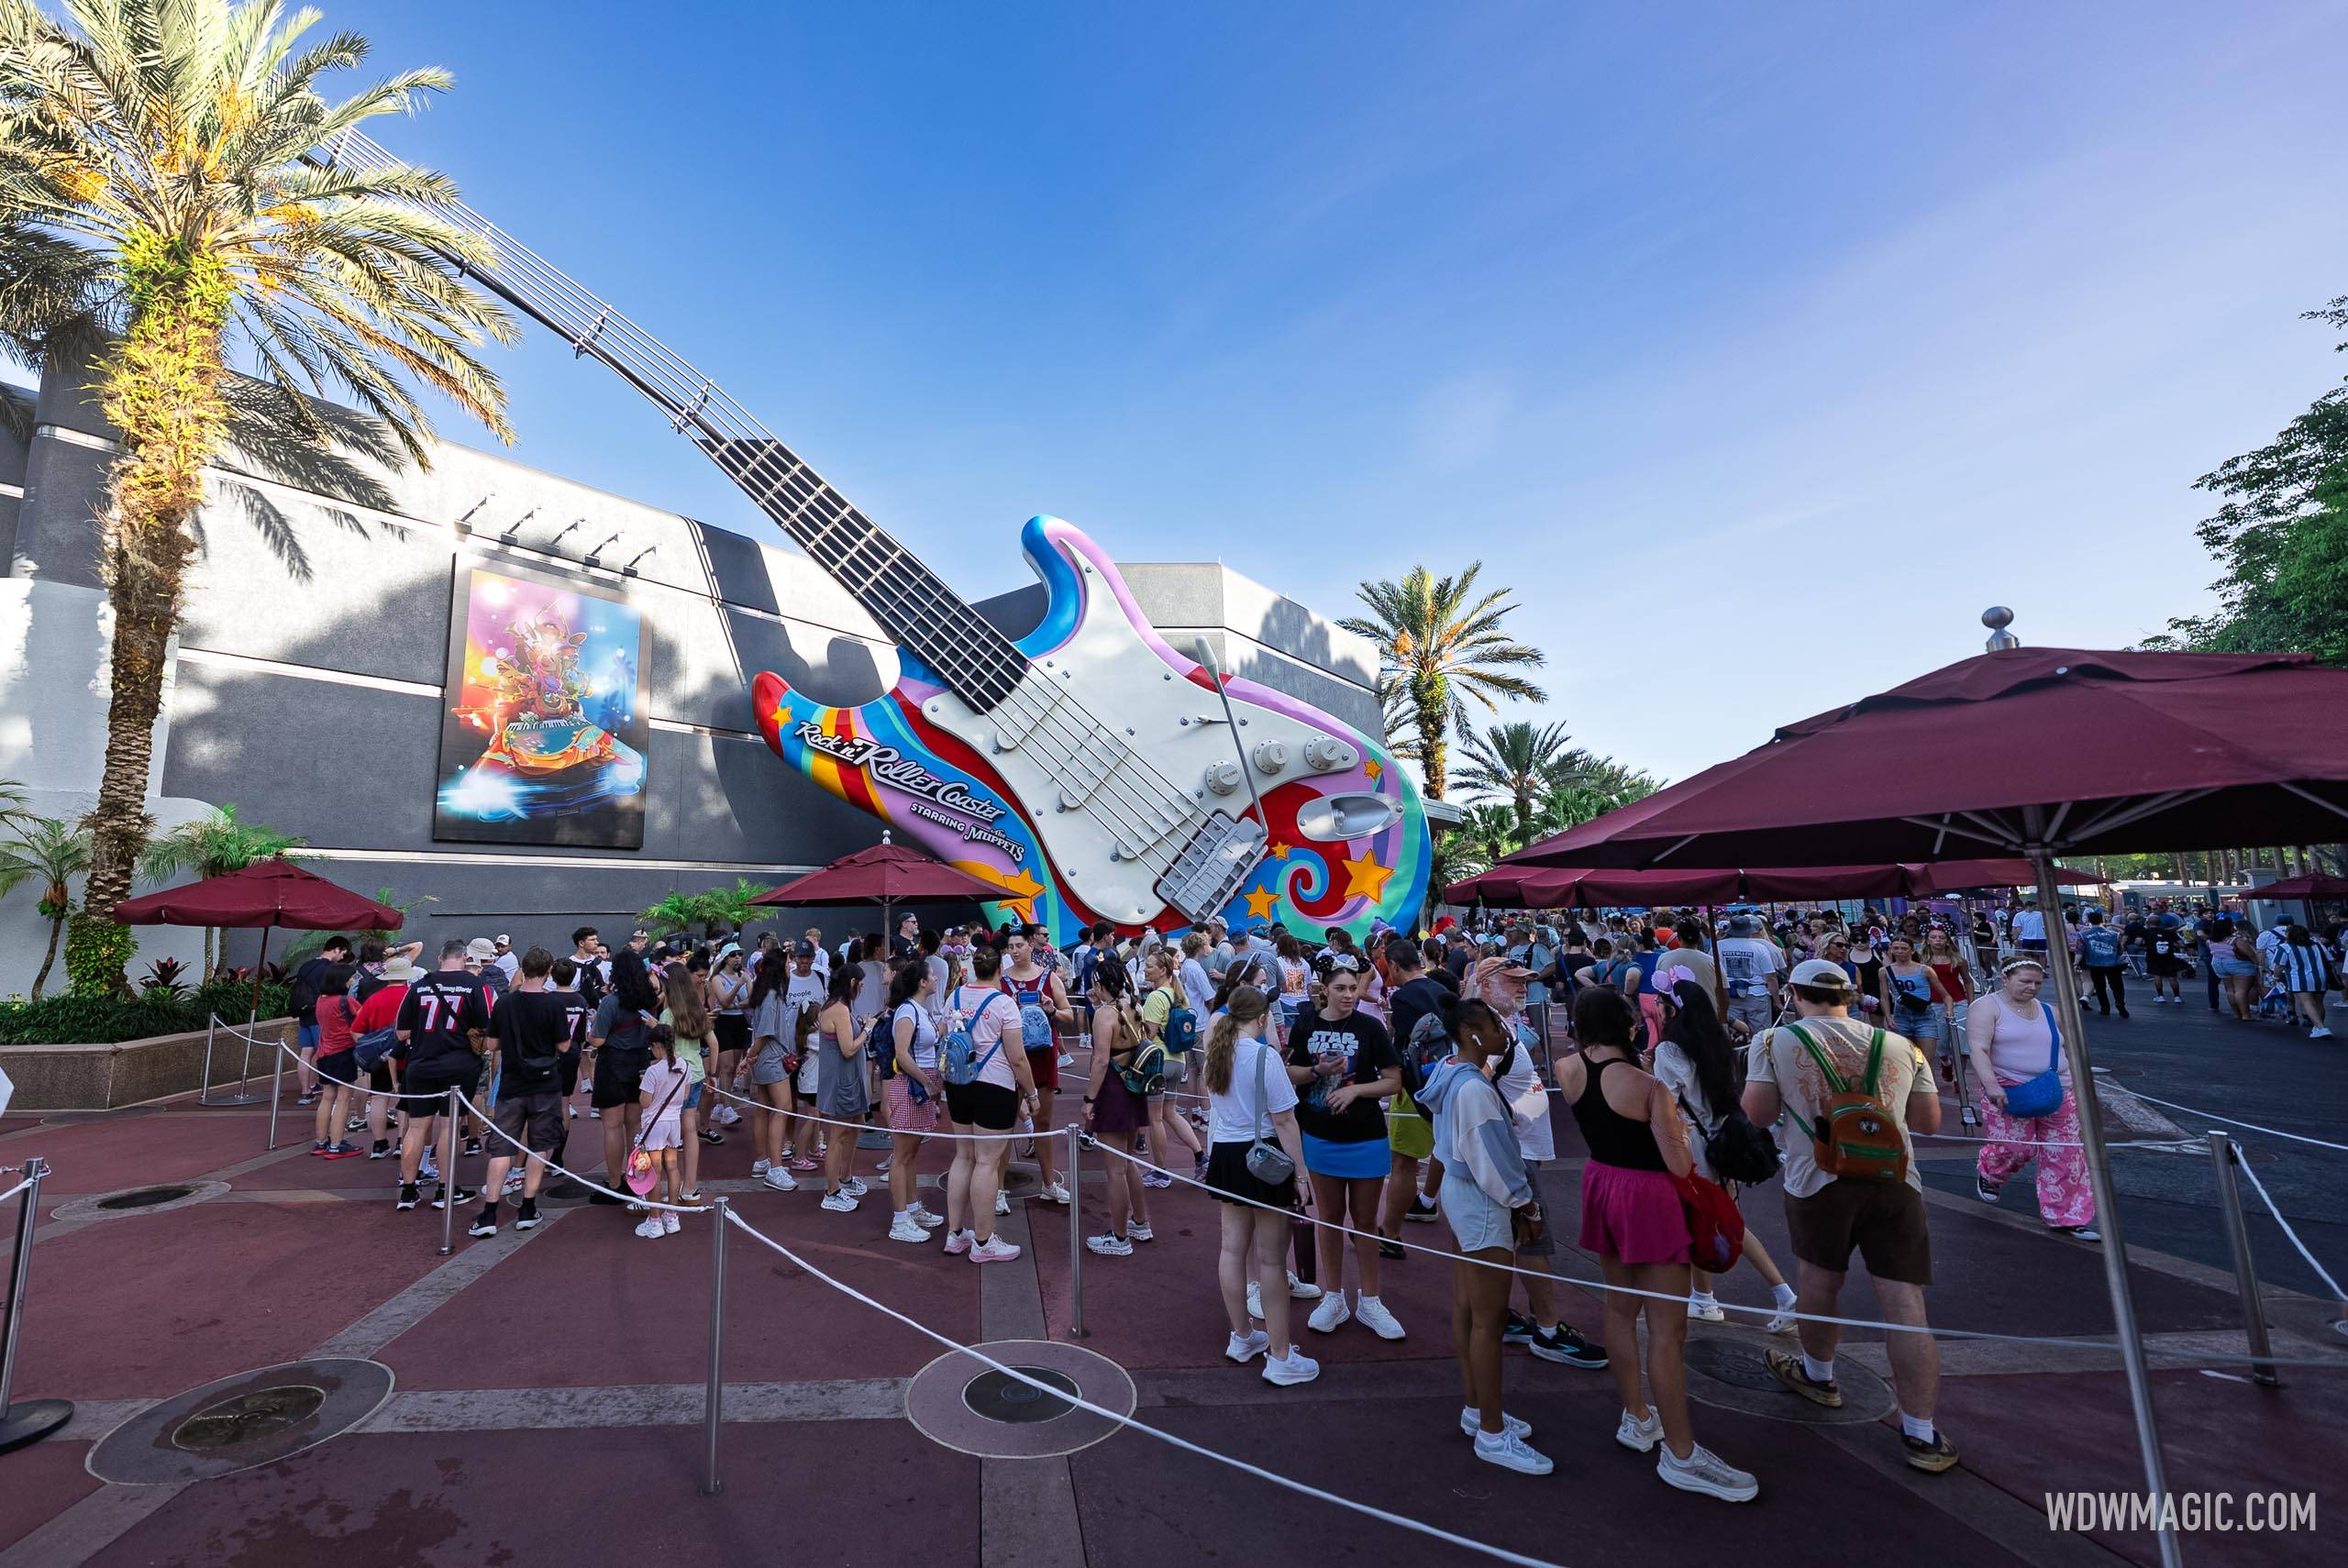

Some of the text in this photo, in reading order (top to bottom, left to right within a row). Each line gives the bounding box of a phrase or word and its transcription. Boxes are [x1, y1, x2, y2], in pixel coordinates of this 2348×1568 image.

[794, 721, 843, 754] Rock
[852, 737, 944, 800] Roller
[936, 782, 1006, 823] Coaster
[1221, 768, 1239, 780] VOLUME
[911, 802, 966, 832] STARRING
[963, 825, 1025, 862] MUPPETS
[788, 990, 812, 999] People
[419, 995, 464, 1032] 77
[1307, 1030, 1359, 1045] STAR
